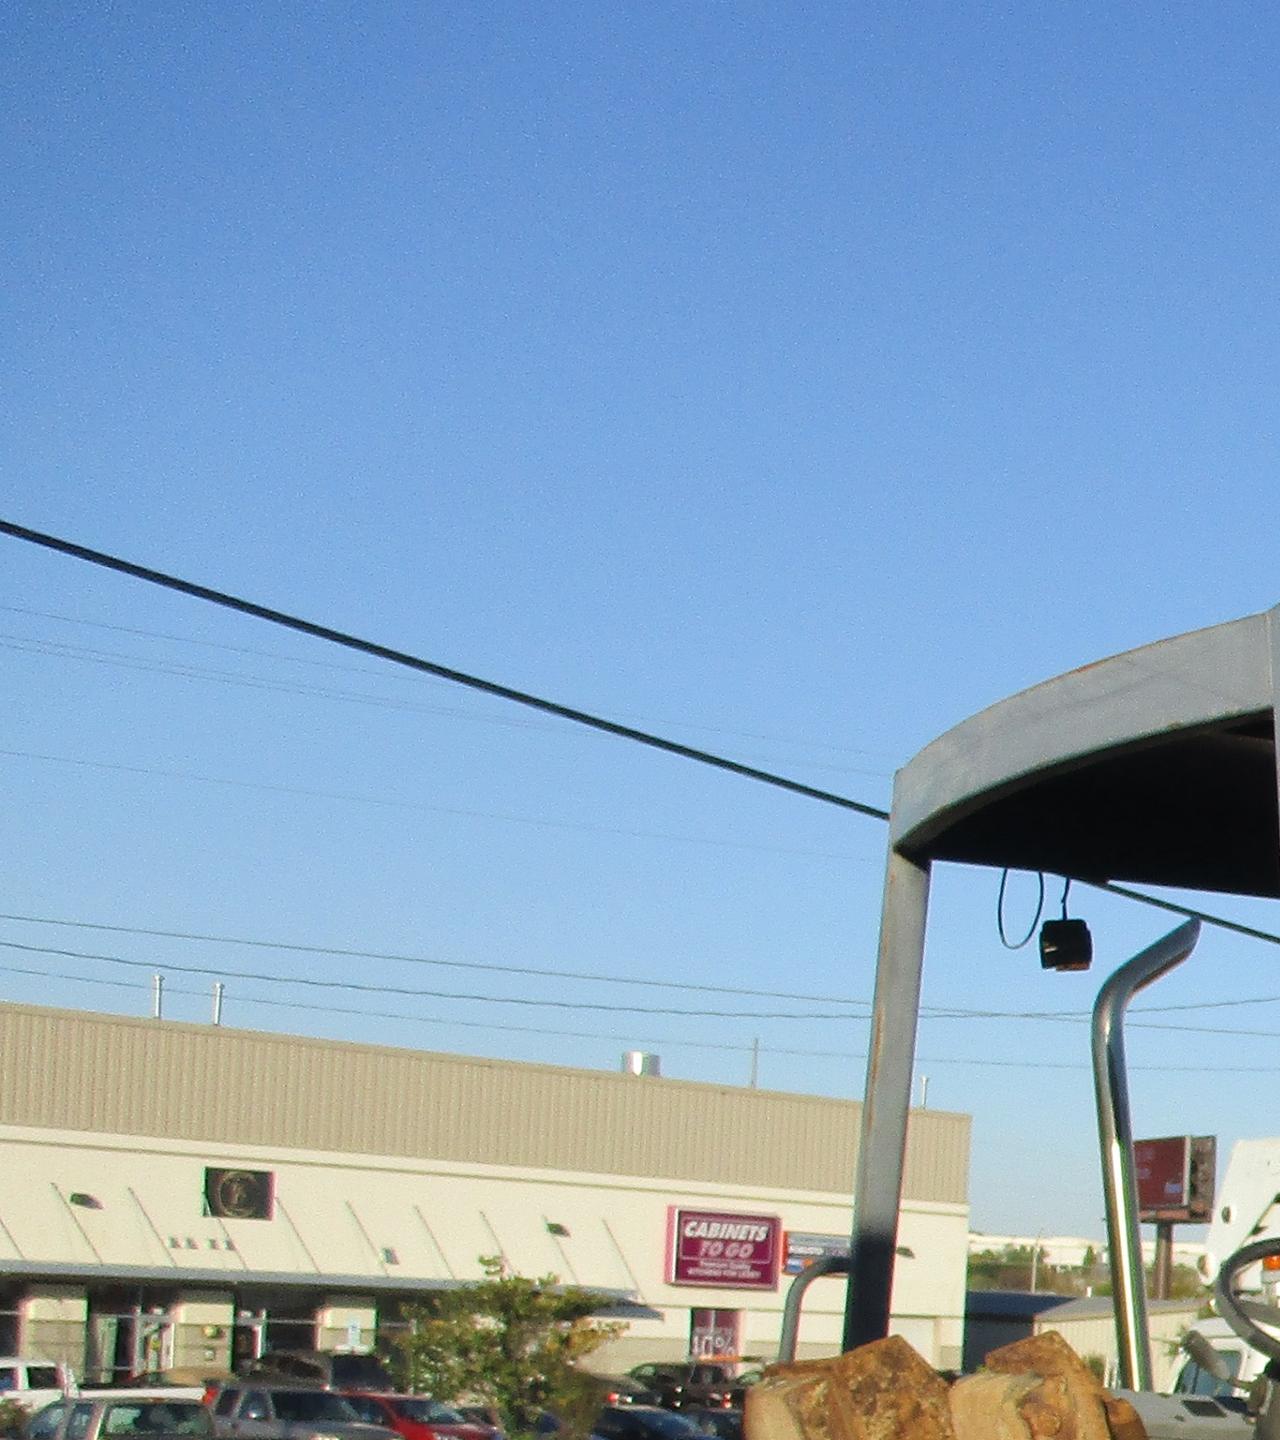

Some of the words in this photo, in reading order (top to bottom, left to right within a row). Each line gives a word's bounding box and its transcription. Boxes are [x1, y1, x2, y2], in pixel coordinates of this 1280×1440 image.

[684, 1220, 769, 1242] CABINETS
[700, 1240, 724, 1257] TO
[725, 1242, 754, 1259] GO
